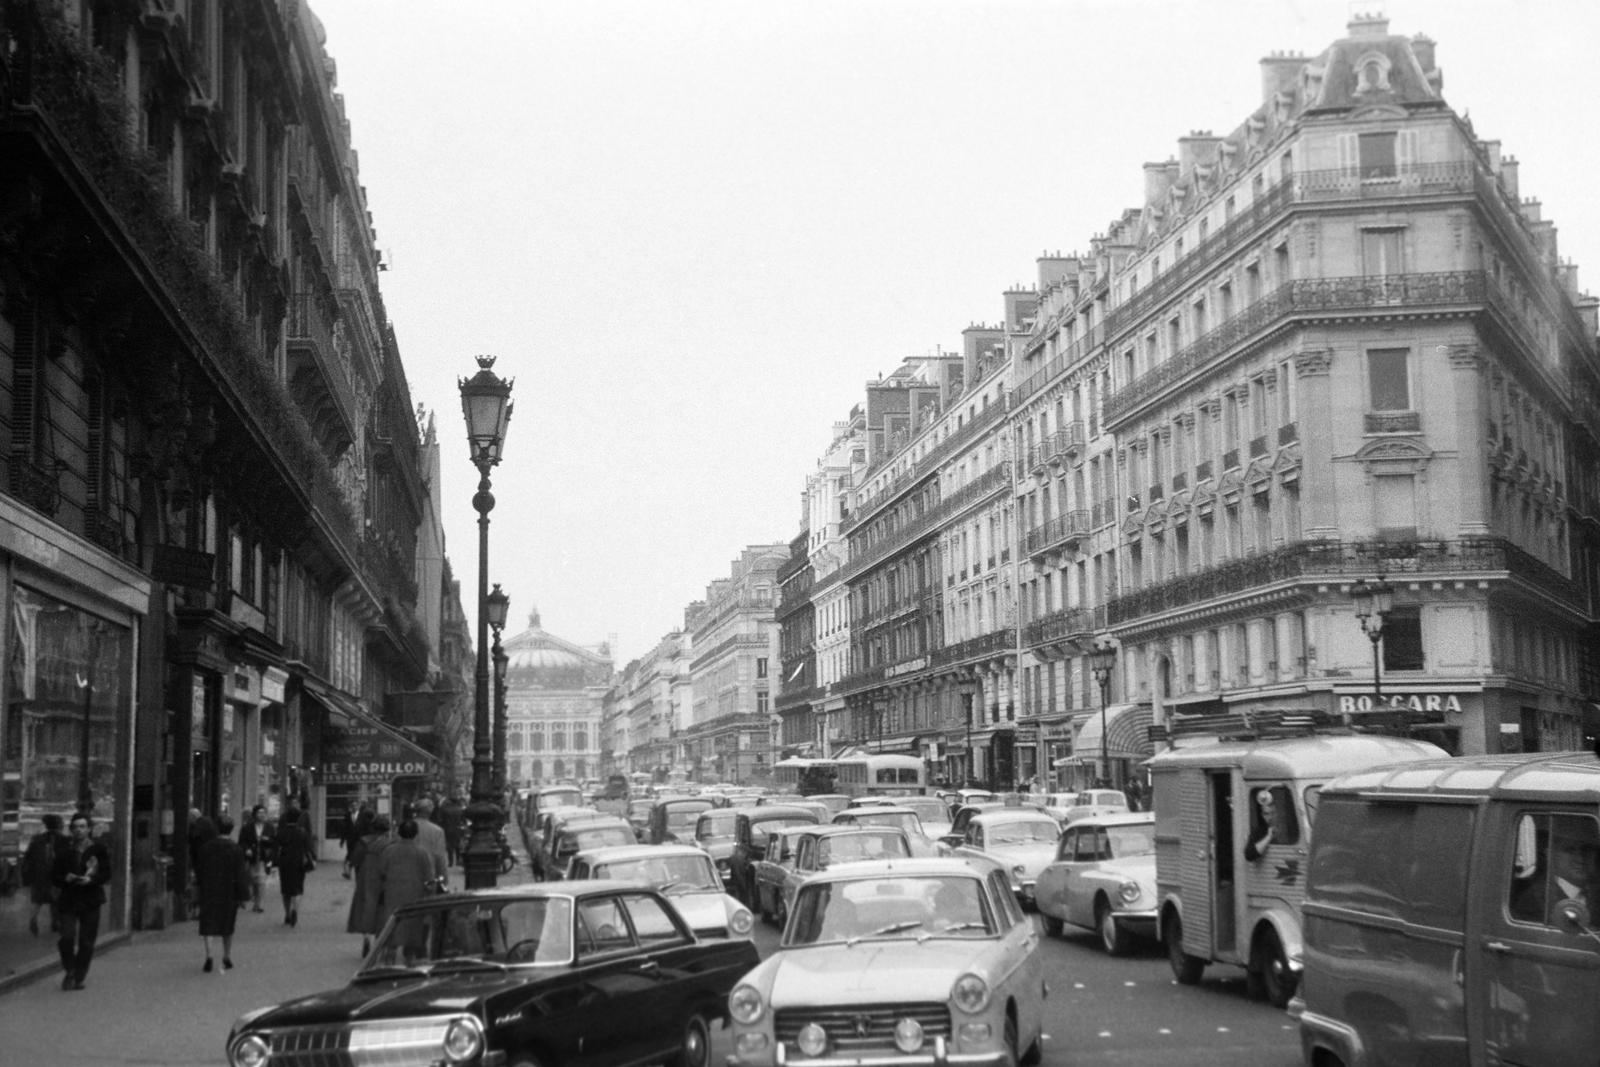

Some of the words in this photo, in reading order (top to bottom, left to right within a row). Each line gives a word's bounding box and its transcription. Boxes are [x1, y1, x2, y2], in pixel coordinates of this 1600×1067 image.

[1340, 695, 1463, 712] BOCARA
[323, 763, 339, 773] LE
[347, 763, 425, 773] CARILLON
